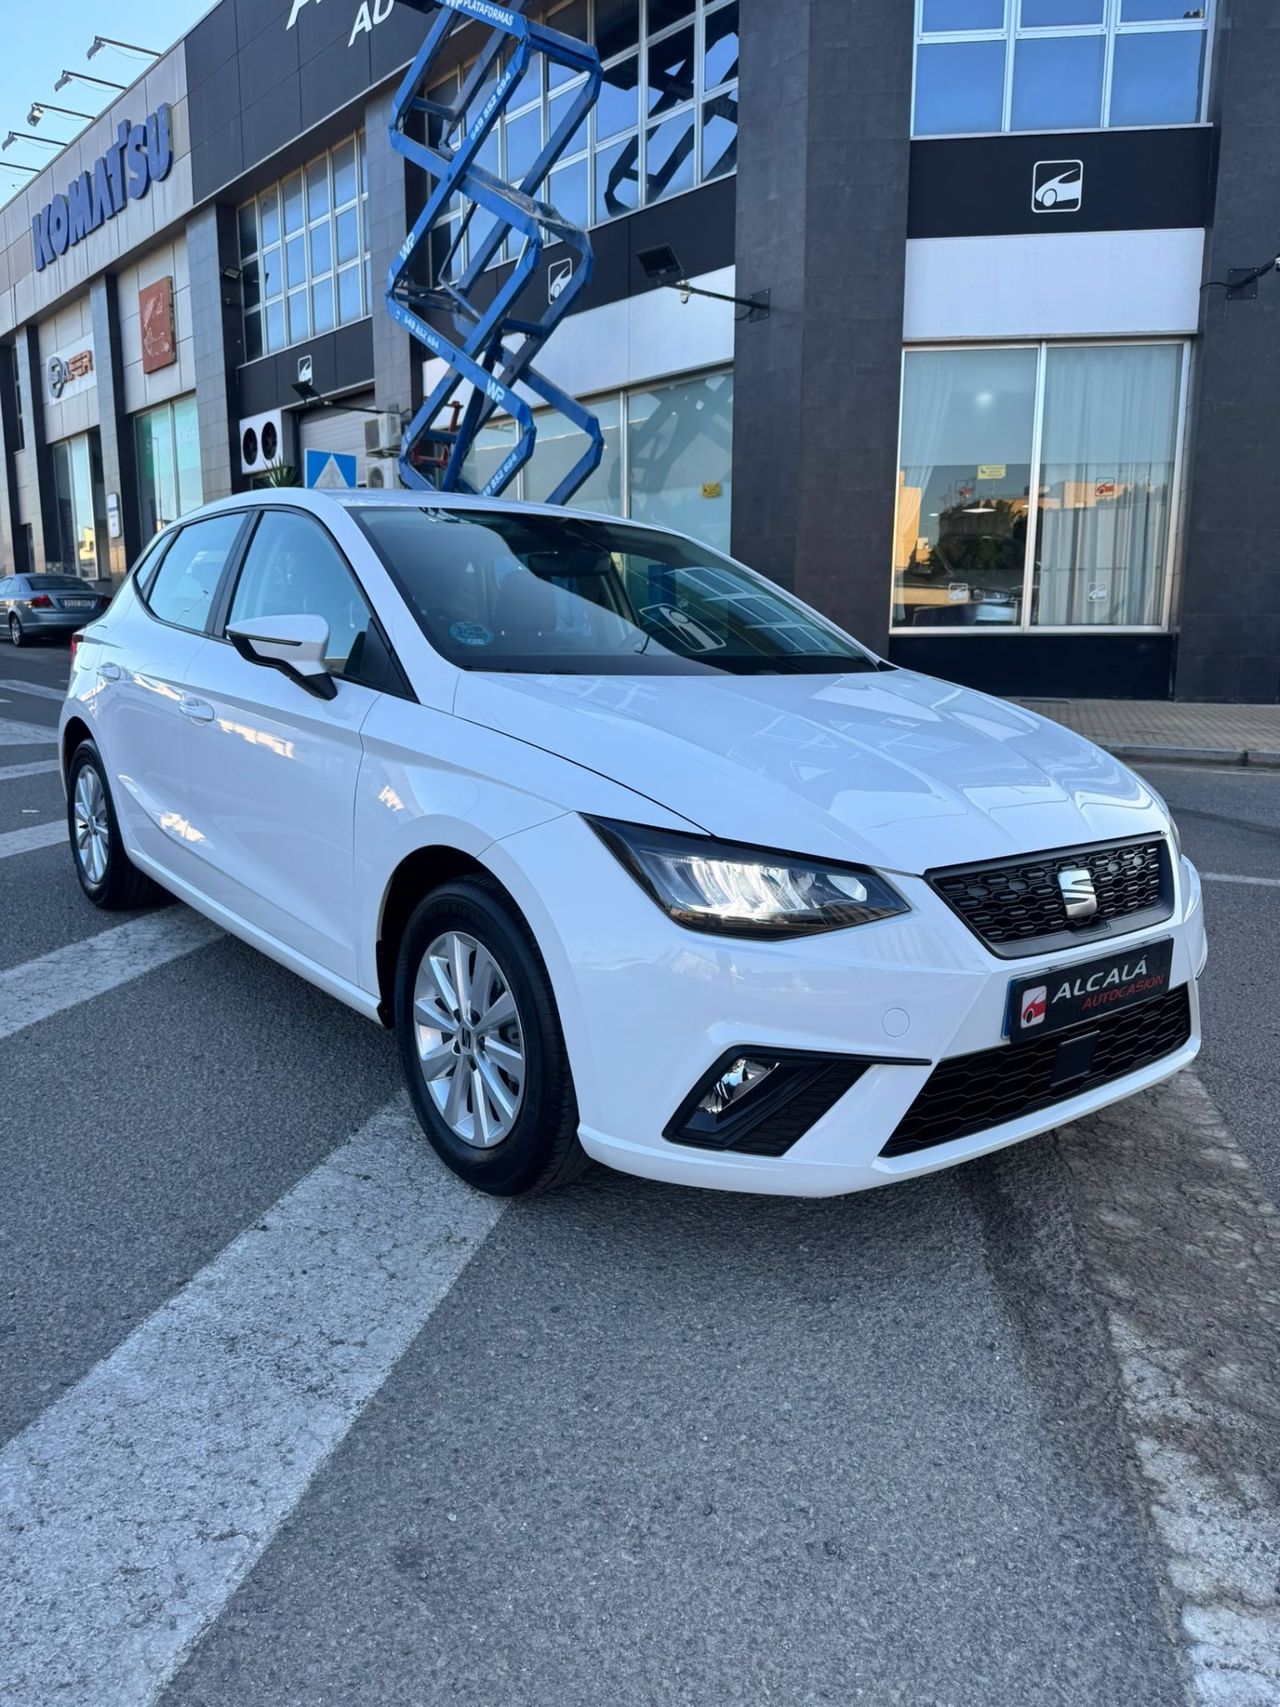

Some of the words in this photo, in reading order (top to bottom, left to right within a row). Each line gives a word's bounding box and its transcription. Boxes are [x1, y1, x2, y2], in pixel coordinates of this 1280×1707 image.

[462, 0, 514, 26] PLATAFORMAS
[31, 102, 173, 272] KOMATSU
[399, 231, 415, 260] WP
[487, 378, 505, 402] WP
[1051, 954, 1148, 1004] ALCALÁ
[1082, 975, 1165, 1011] AUTOCASION
